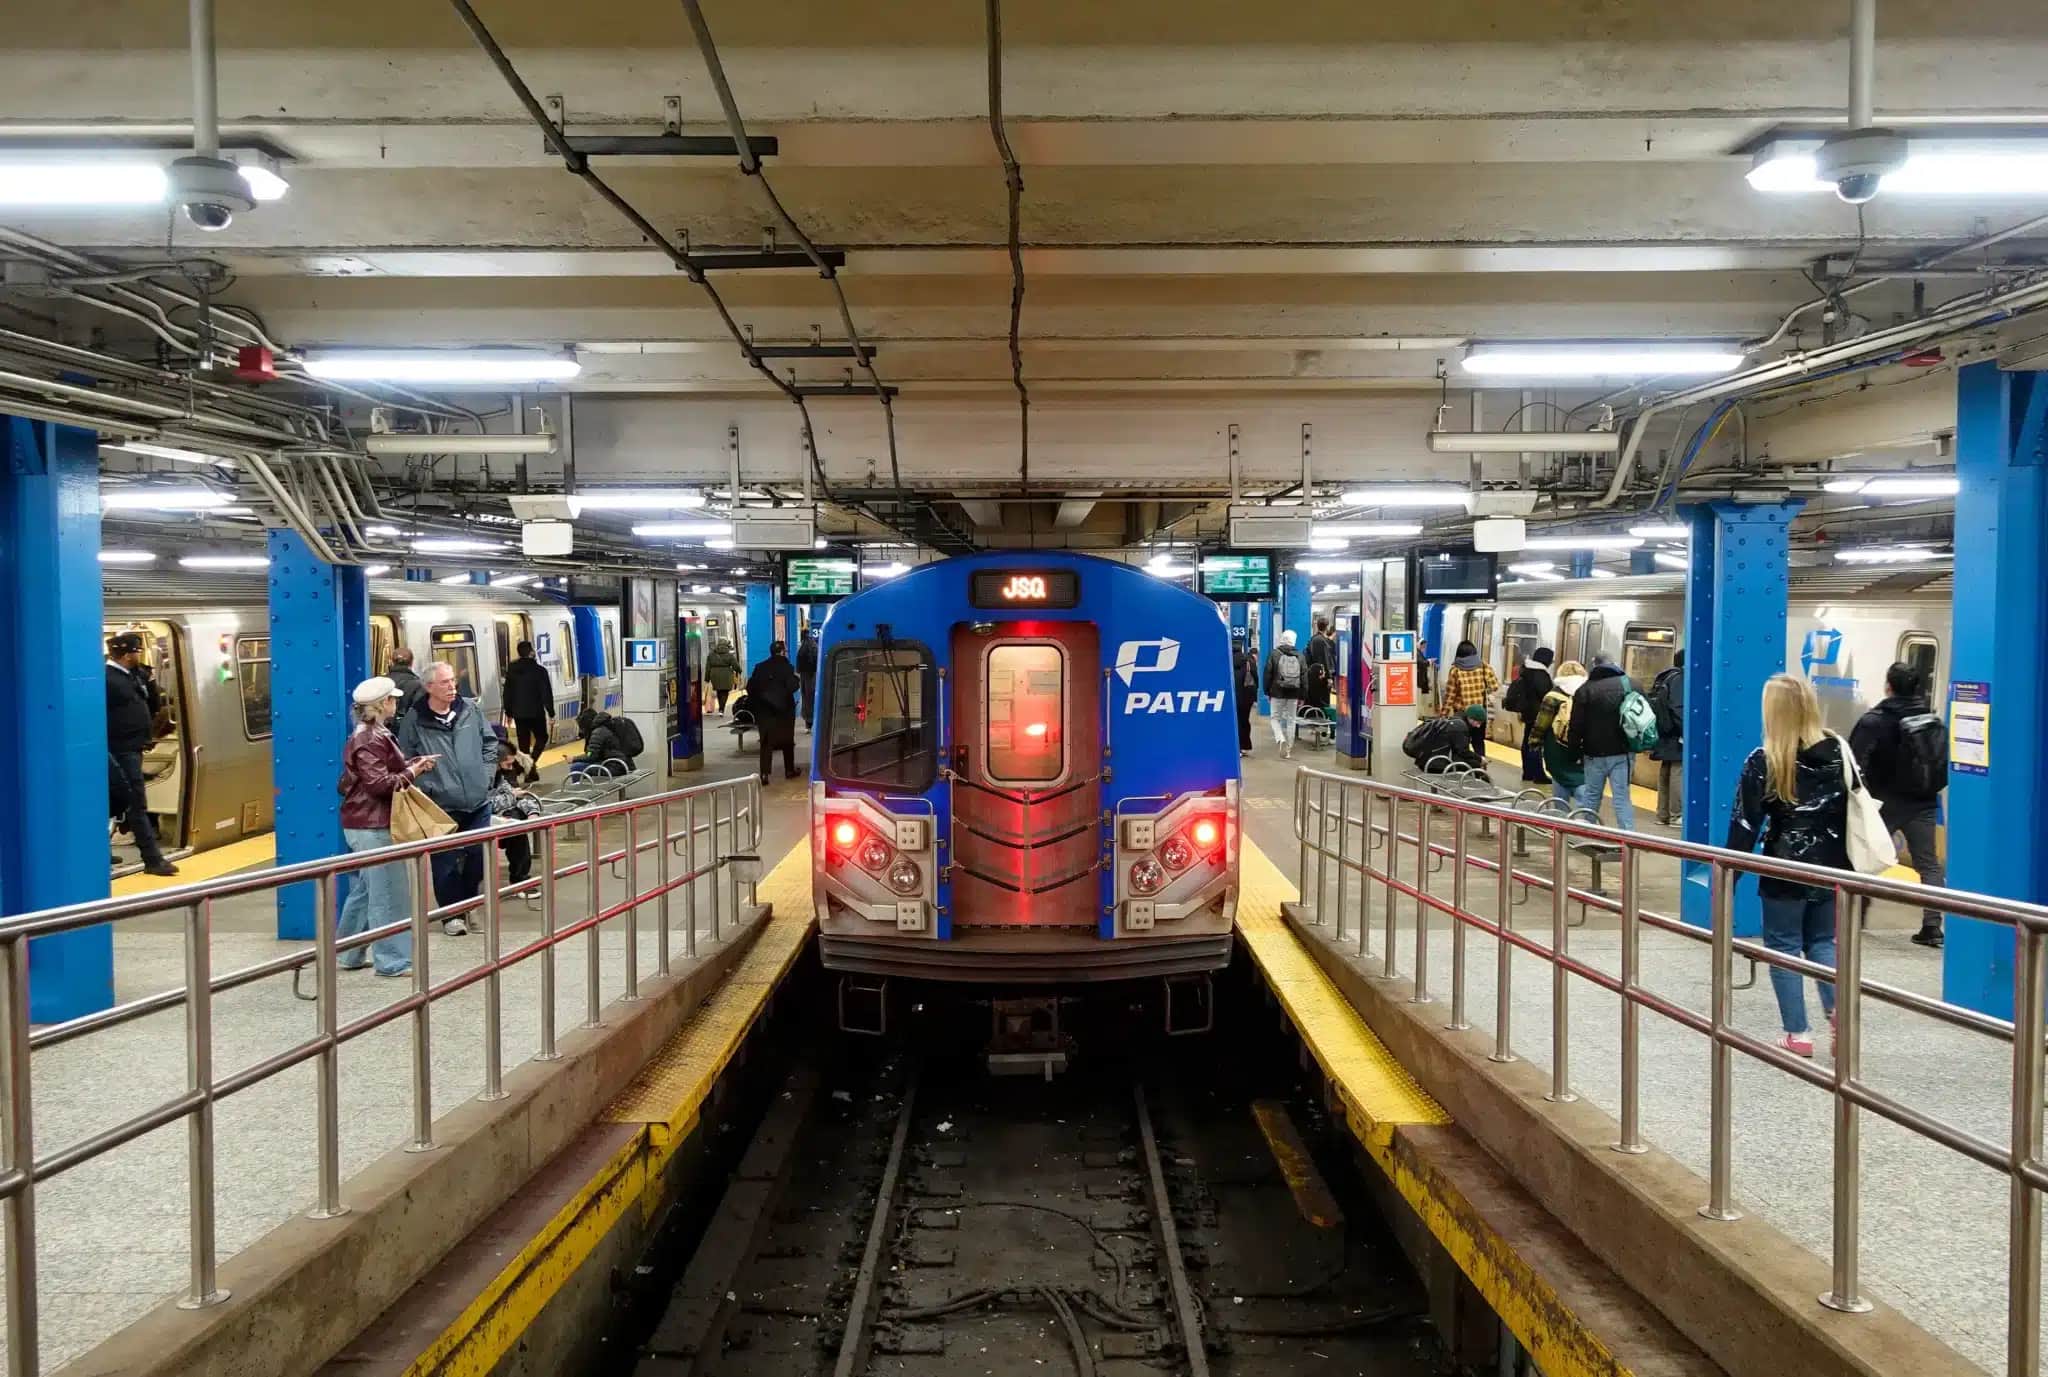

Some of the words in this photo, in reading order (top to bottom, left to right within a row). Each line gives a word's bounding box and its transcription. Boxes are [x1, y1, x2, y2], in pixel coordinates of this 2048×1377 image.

[1003, 576, 1046, 599] JSQ
[1233, 627, 1246, 636] 33
[1124, 691, 1225, 714] PATH
